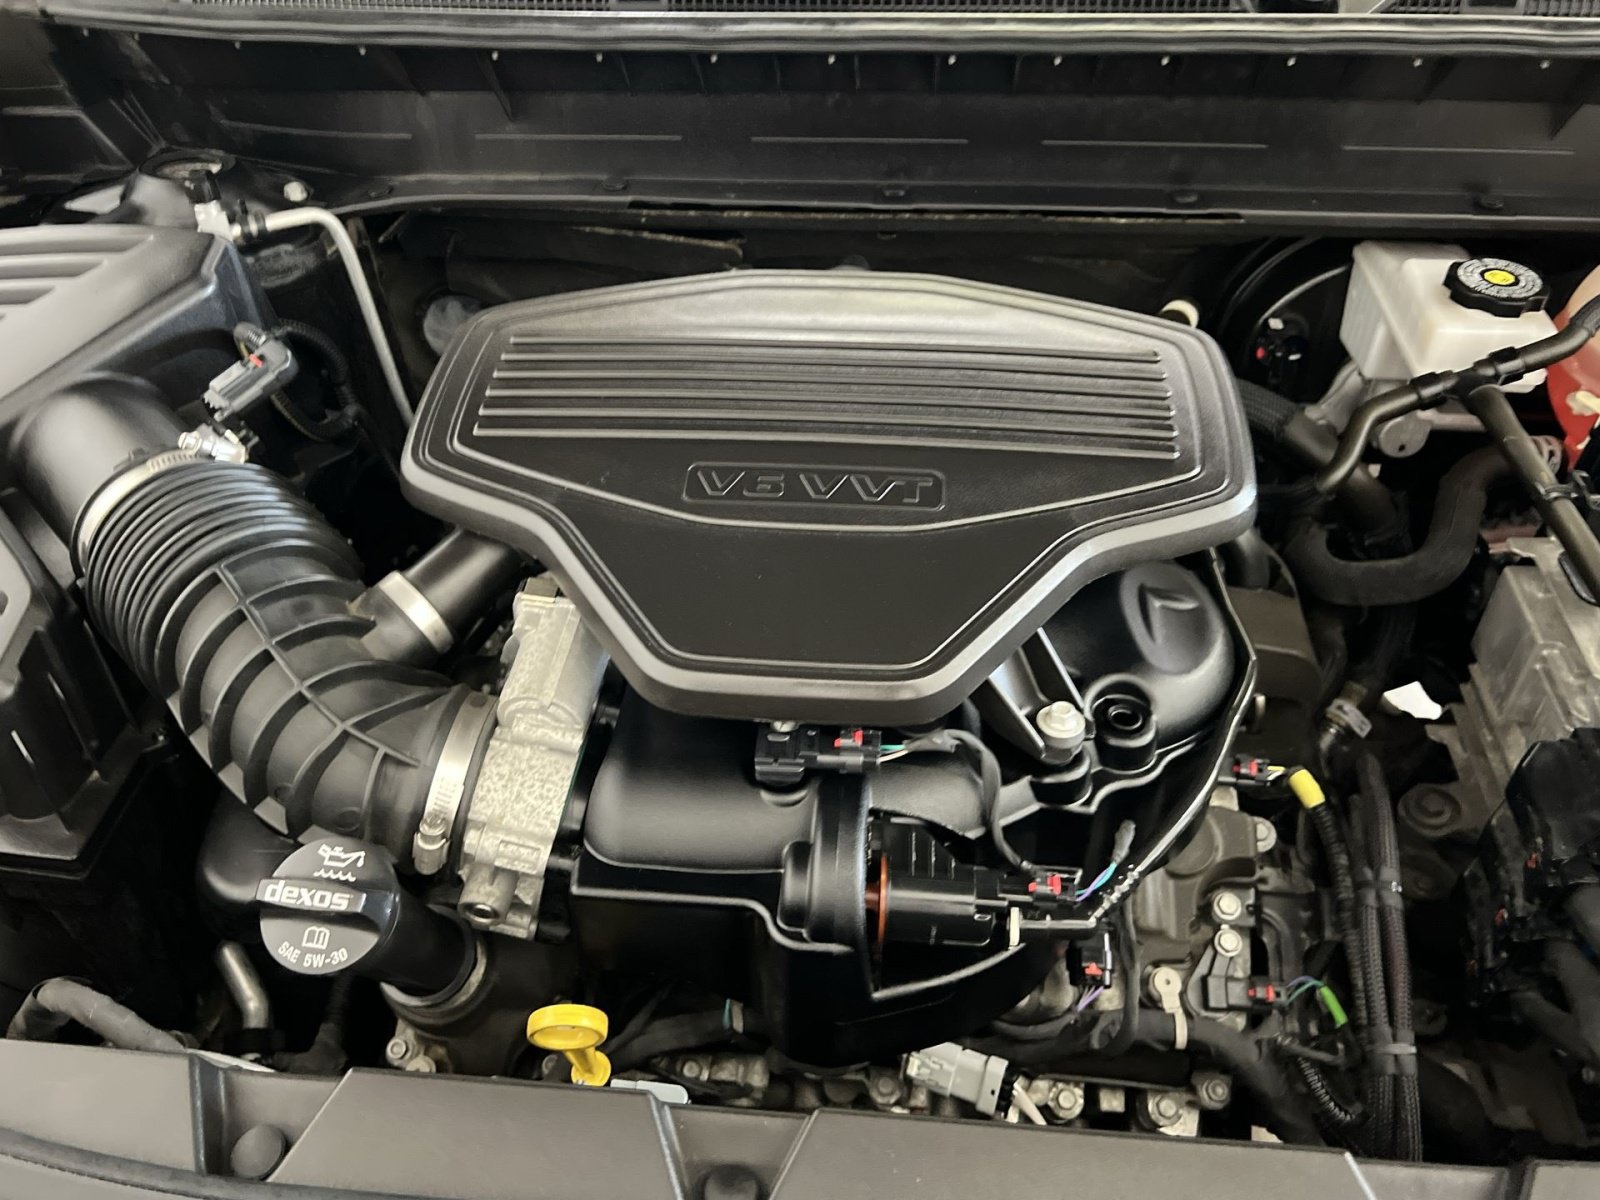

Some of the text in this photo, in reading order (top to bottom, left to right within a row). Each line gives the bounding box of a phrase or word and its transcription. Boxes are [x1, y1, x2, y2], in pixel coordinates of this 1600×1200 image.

[697, 470, 934, 504] V6 VVT
[264, 879, 351, 911] dexos
[277, 940, 302, 964] SAE
